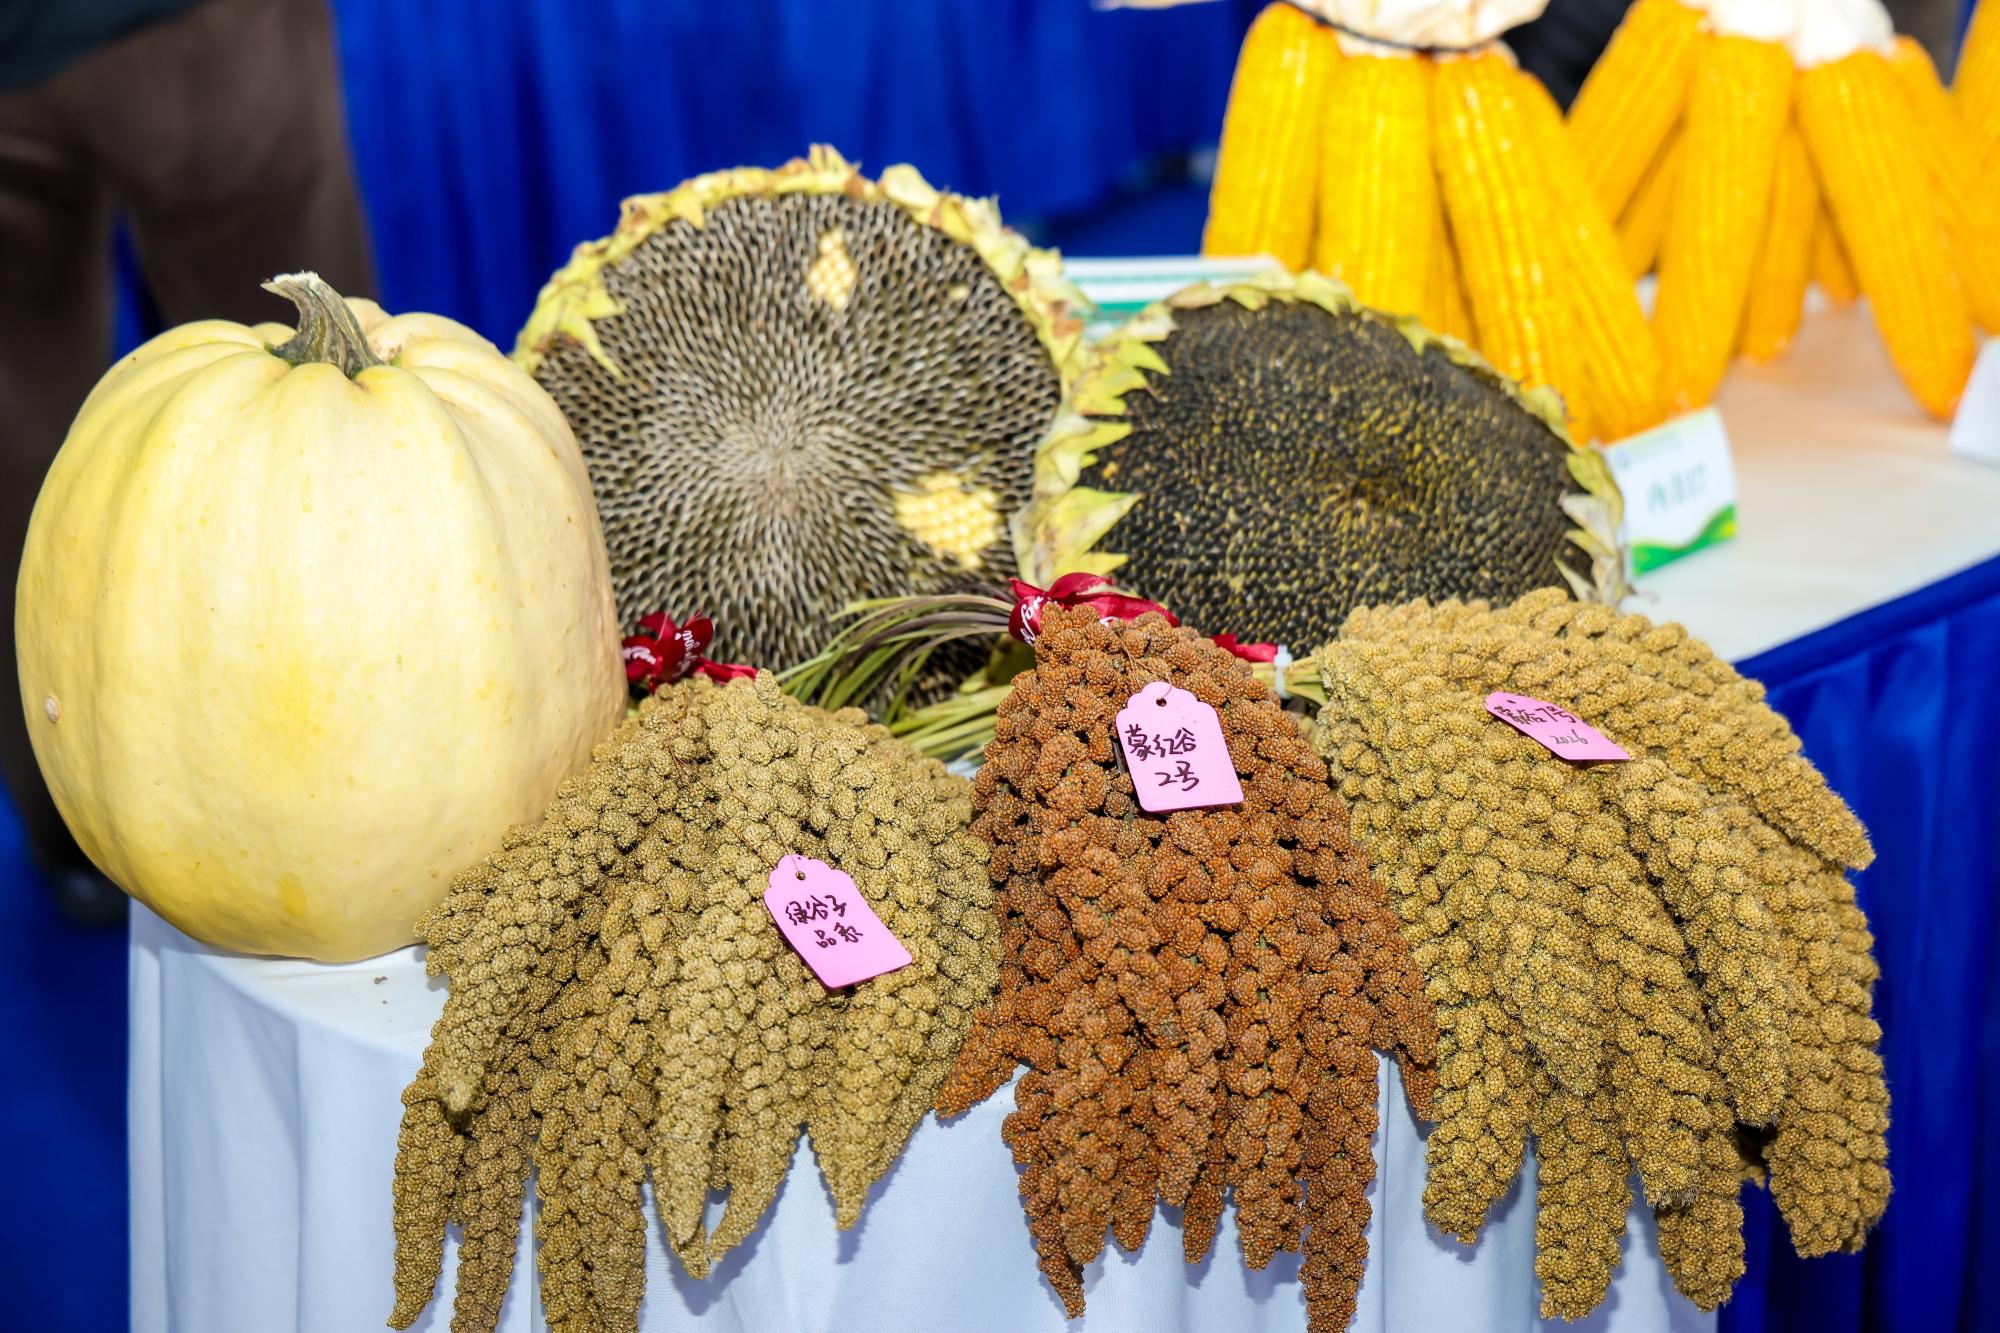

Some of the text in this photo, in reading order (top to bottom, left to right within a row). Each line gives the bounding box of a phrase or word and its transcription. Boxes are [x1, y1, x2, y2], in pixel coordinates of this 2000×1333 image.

[1124, 723, 1197, 762] 蒙红谷
[1154, 760, 1200, 792] 2号
